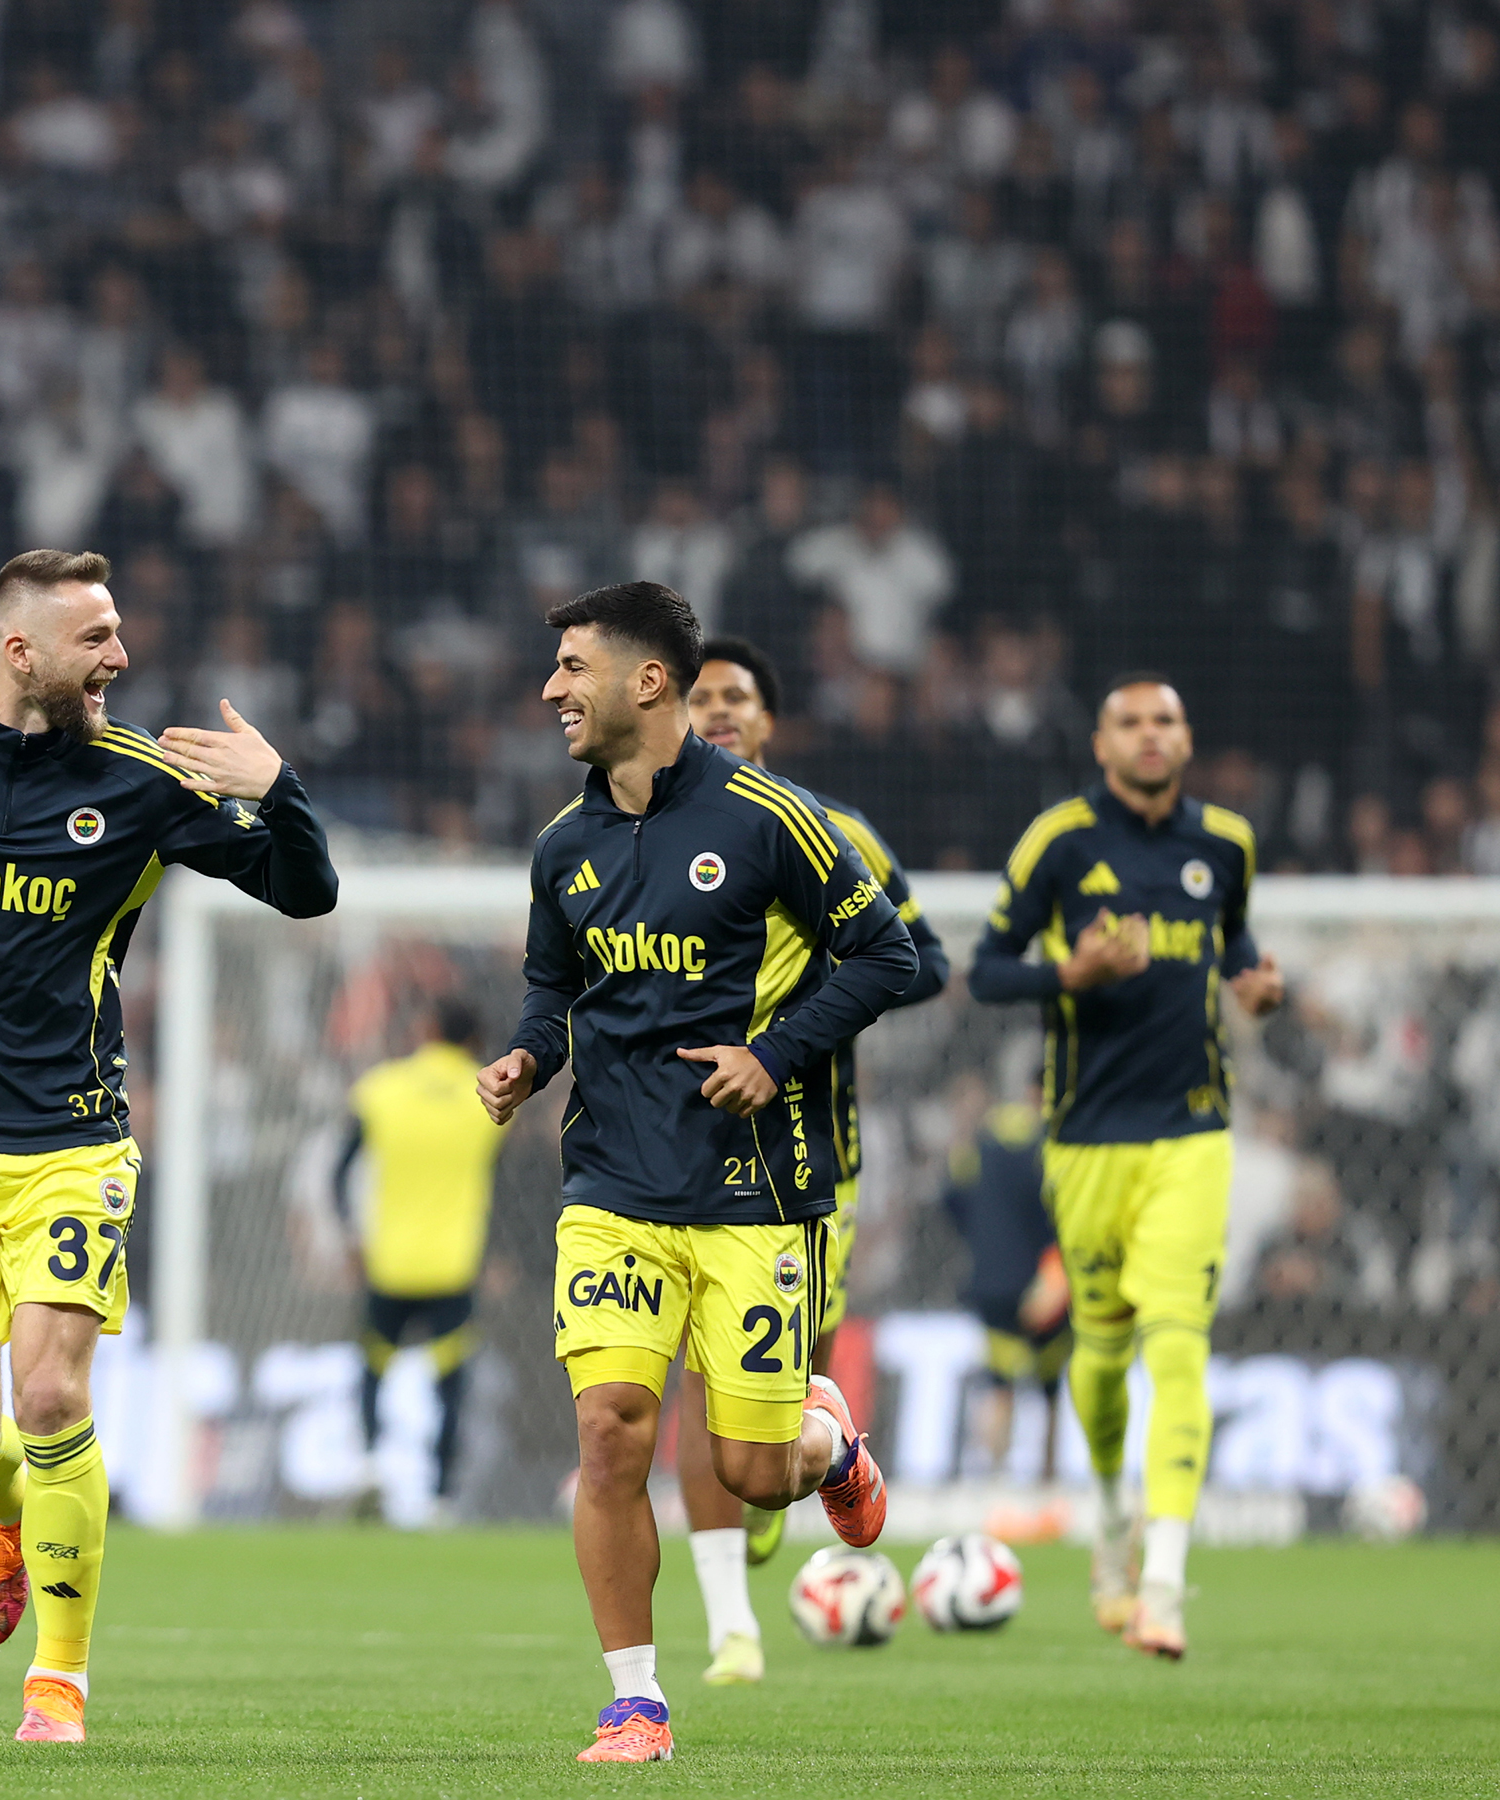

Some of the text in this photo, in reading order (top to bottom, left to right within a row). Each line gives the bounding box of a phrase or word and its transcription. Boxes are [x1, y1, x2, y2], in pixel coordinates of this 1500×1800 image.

[828, 874, 883, 928] NESİN
[585, 922, 706, 981] Otokoç
[68, 1088, 104, 1117] 37
[724, 1156, 757, 1185] 21
[48, 1216, 122, 1291] 37
[741, 1303, 801, 1374] 21
